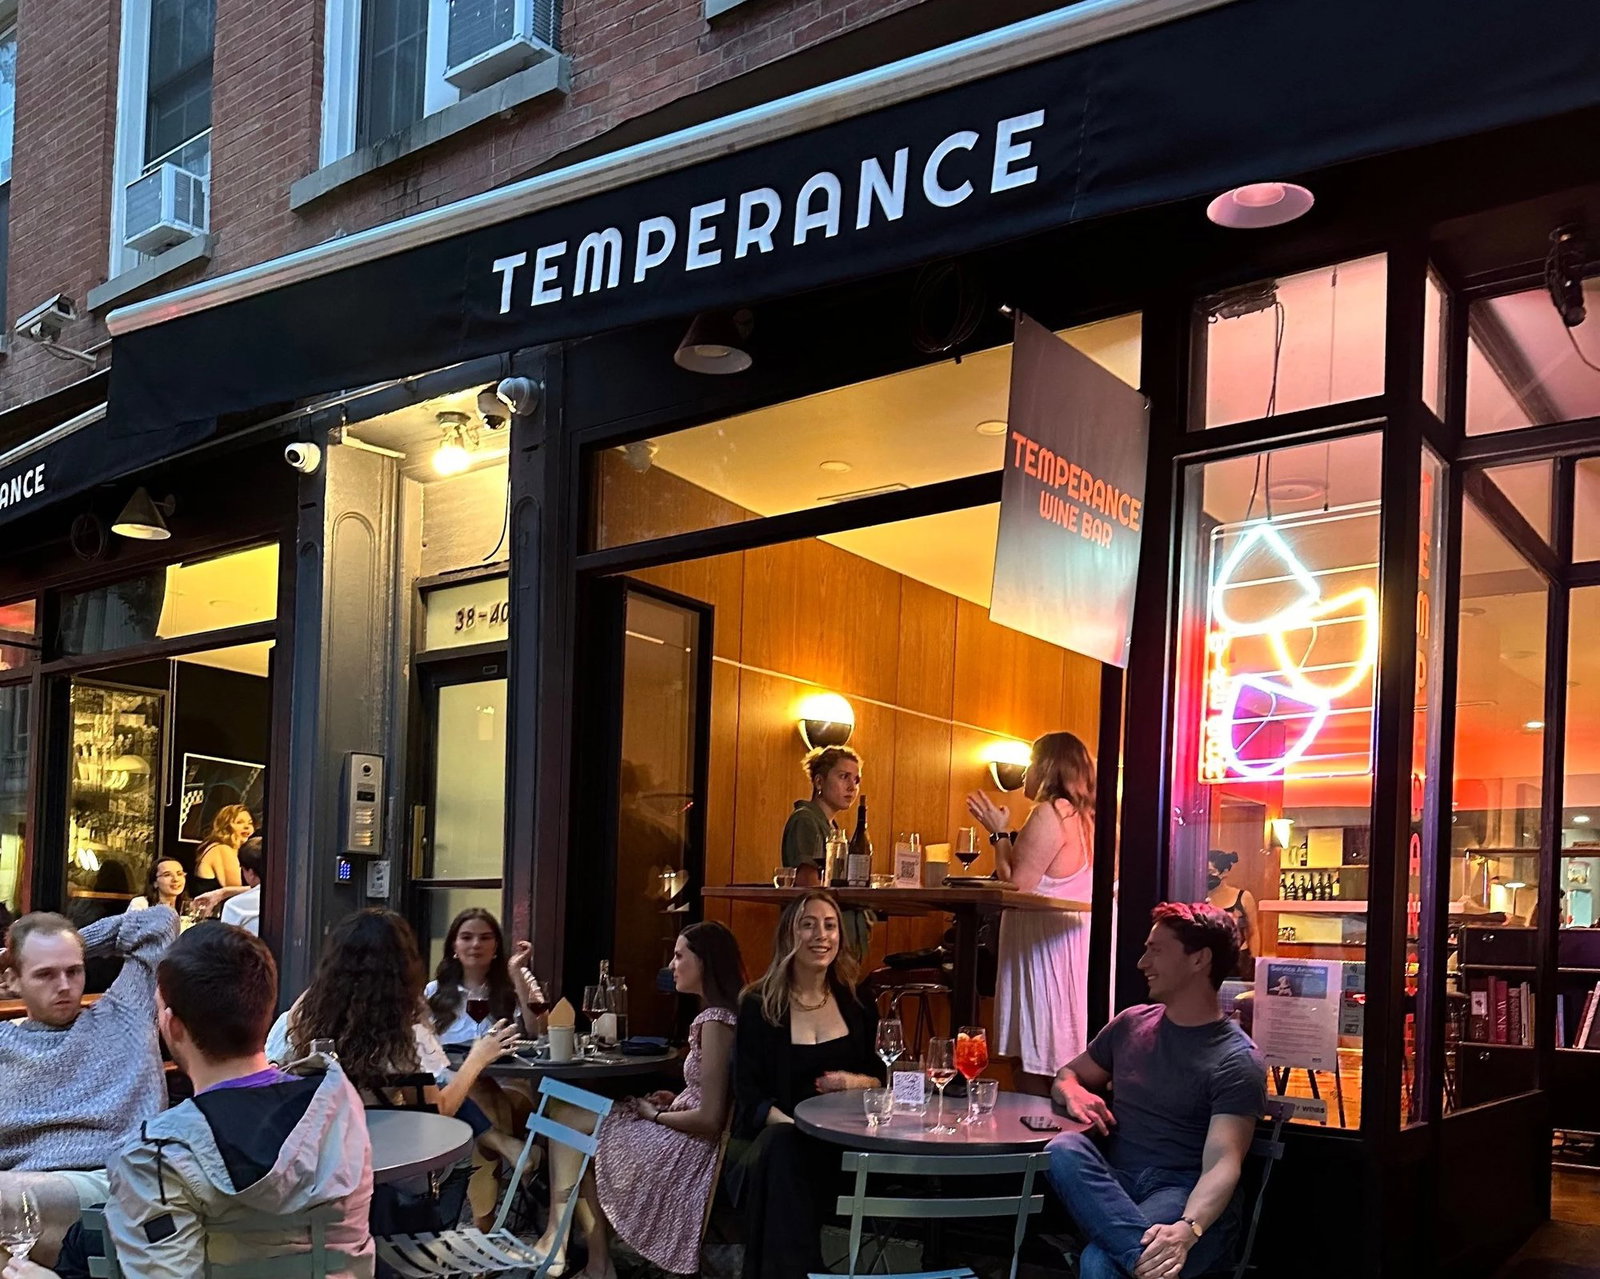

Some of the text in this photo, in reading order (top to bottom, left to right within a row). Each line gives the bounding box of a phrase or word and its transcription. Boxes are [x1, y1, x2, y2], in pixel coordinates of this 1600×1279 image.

[491, 108, 1046, 315] TEMPERANCE
[0, 463, 46, 510] ANCE
[1011, 431, 1144, 533] TEMPERANCE
[1039, 490, 1114, 550] WINE BAR
[454, 602, 509, 631] 38-40
[1406, 471, 1433, 1057] TEMPRANCE
